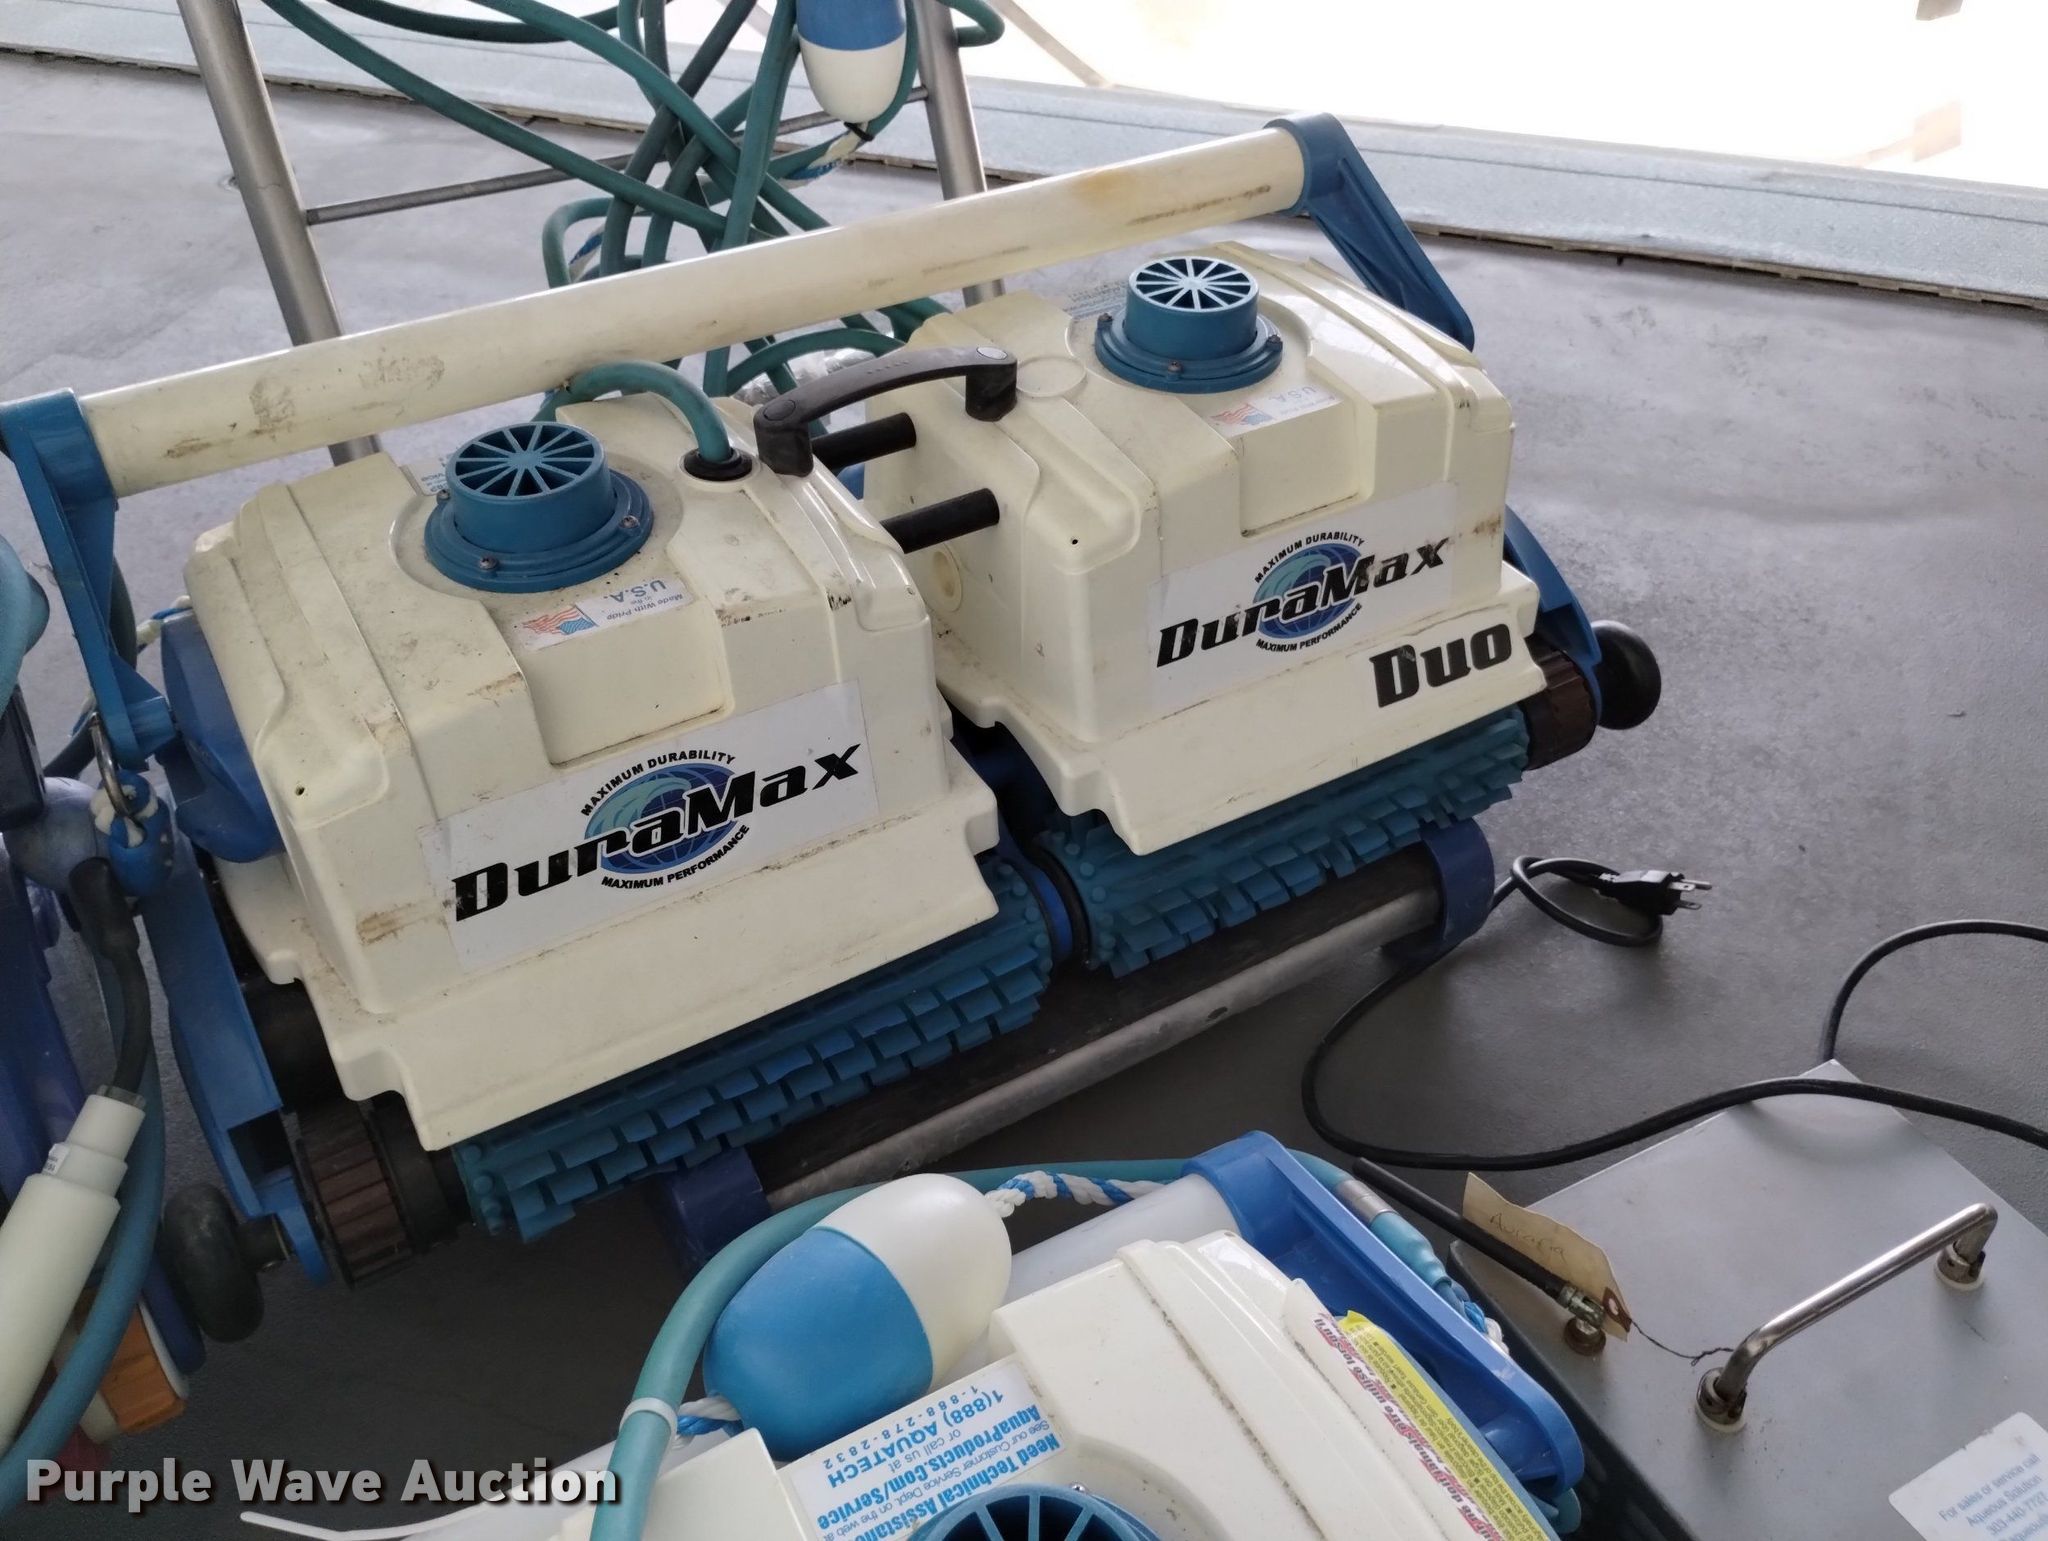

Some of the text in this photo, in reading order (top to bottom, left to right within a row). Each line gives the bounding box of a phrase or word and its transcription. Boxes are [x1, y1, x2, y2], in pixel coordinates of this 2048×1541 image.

[1254, 531, 1365, 584] MAXIMUM DURABILITY
[635, 601, 656, 613] With
[1156, 536, 1450, 668] DuraMax
[1255, 602, 1363, 653] MAXIMUM PERFORMANCE
[1369, 623, 1512, 708] Duo
[581, 750, 736, 817] MAXIMUM DURABILITY
[451, 743, 861, 922] DuraMax
[601, 824, 750, 890] MAXIMUM PERFORMANCE
[827, 1389, 1003, 1489] 1(888) AQUATECH
[1012, 1430, 1028, 1444] our
[1017, 1433, 1060, 1465] Need
[1029, 1420, 1050, 1434] See
[817, 1404, 1041, 1530] AquaProducts.Com/Service
[890, 1429, 961, 1474] or call us at
[963, 1441, 1011, 1471] Customer
[899, 1486, 924, 1506] Dept.
[924, 1468, 962, 1489] Service
[937, 1456, 1019, 1509] Technical
[836, 1521, 860, 1537] web
[861, 1510, 878, 1523] the
[878, 1503, 893, 1514] on
